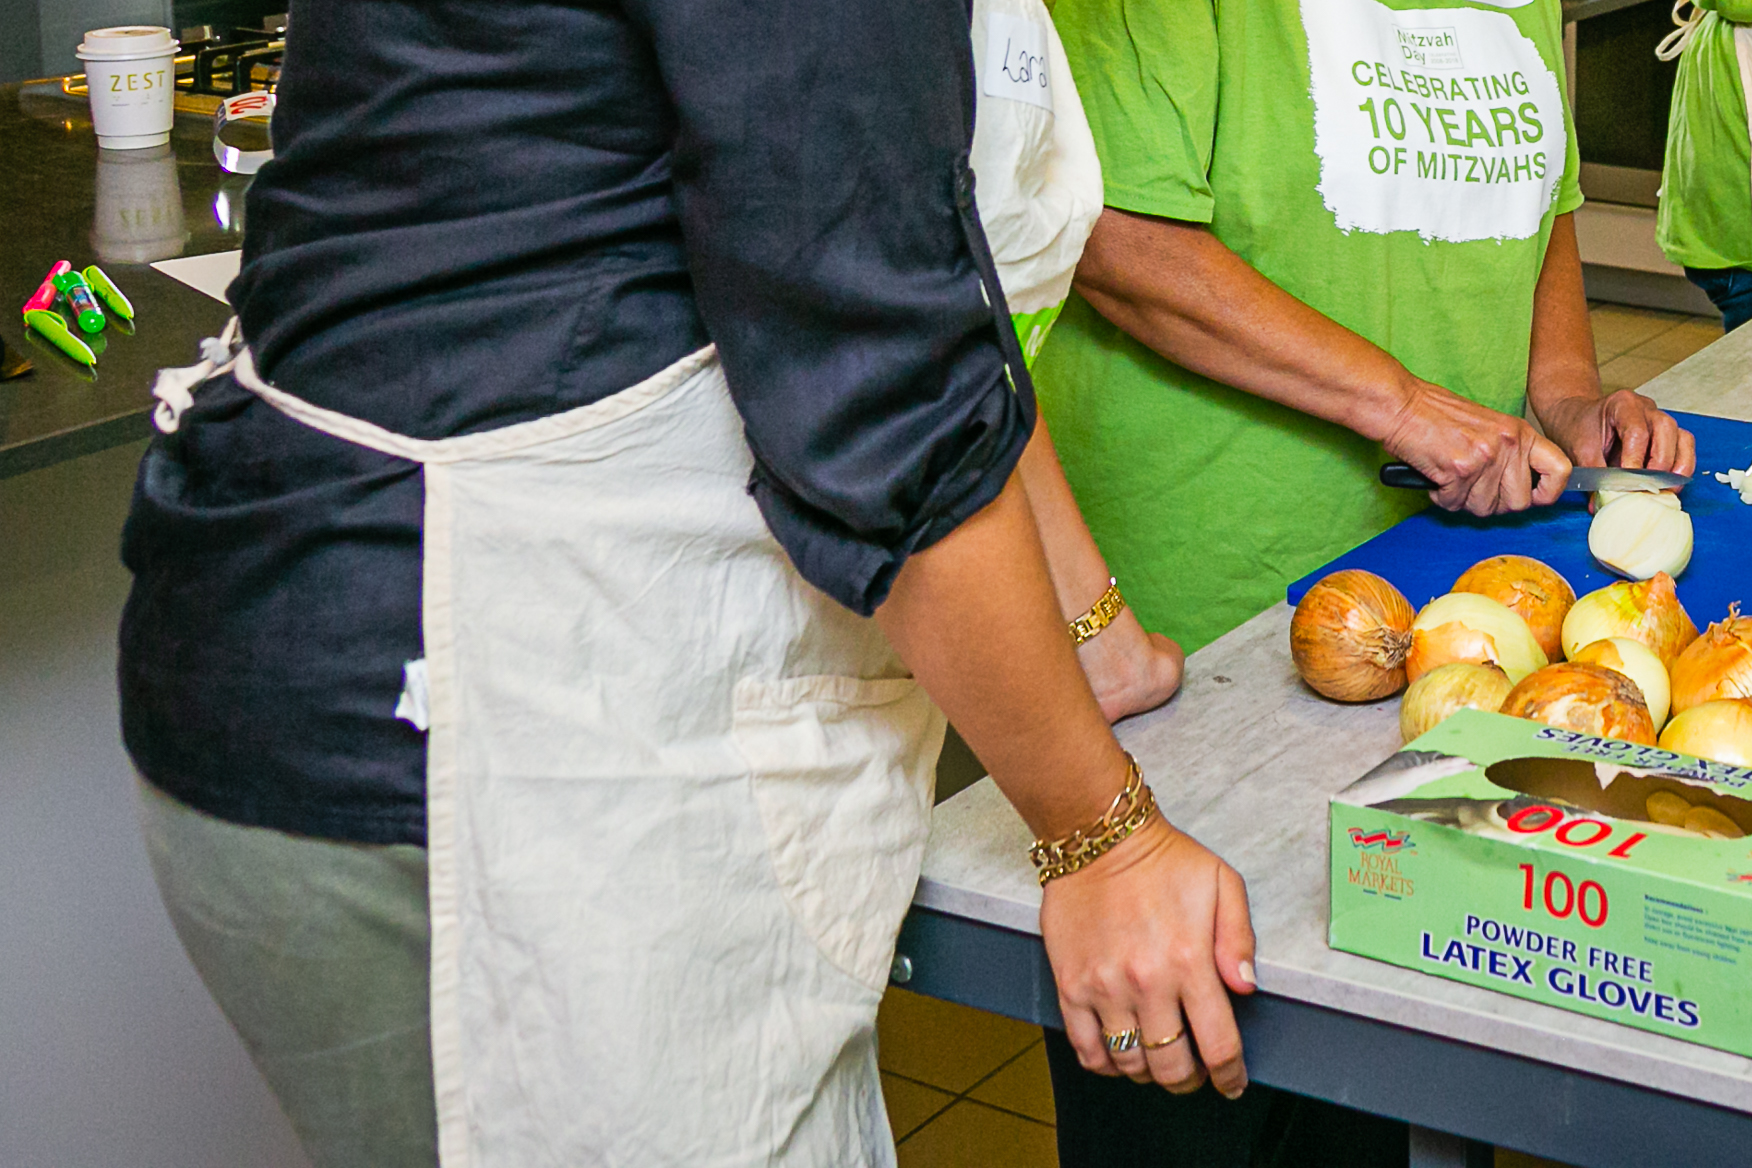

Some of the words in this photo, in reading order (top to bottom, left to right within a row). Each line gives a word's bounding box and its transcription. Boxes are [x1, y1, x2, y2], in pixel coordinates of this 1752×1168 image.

[1397, 29, 1454, 47] Mitzvah
[1401, 45, 1426, 65] Day
[110, 70, 166, 92] ZEST
[1002, 37, 1048, 88] Lara
[1351, 60, 1530, 102] CELEBRATING
[1358, 97, 1407, 142] 10
[1410, 101, 1544, 148] YEARS
[1368, 145, 1407, 175] OF
[1417, 151, 1547, 184] MITZVAHS
[1537, 727, 1681, 763] GLOVES
[1507, 805, 1648, 860] 100
[1348, 867, 1415, 897] MARKETS
[1360, 851, 1403, 875] ROYAL
[1518, 863, 1609, 929] 100
[1465, 914, 1578, 964] POWDER
[1588, 947, 1653, 983] FREE
[1422, 932, 1533, 985] LATEX
[1548, 967, 1700, 1028] GLOVES
